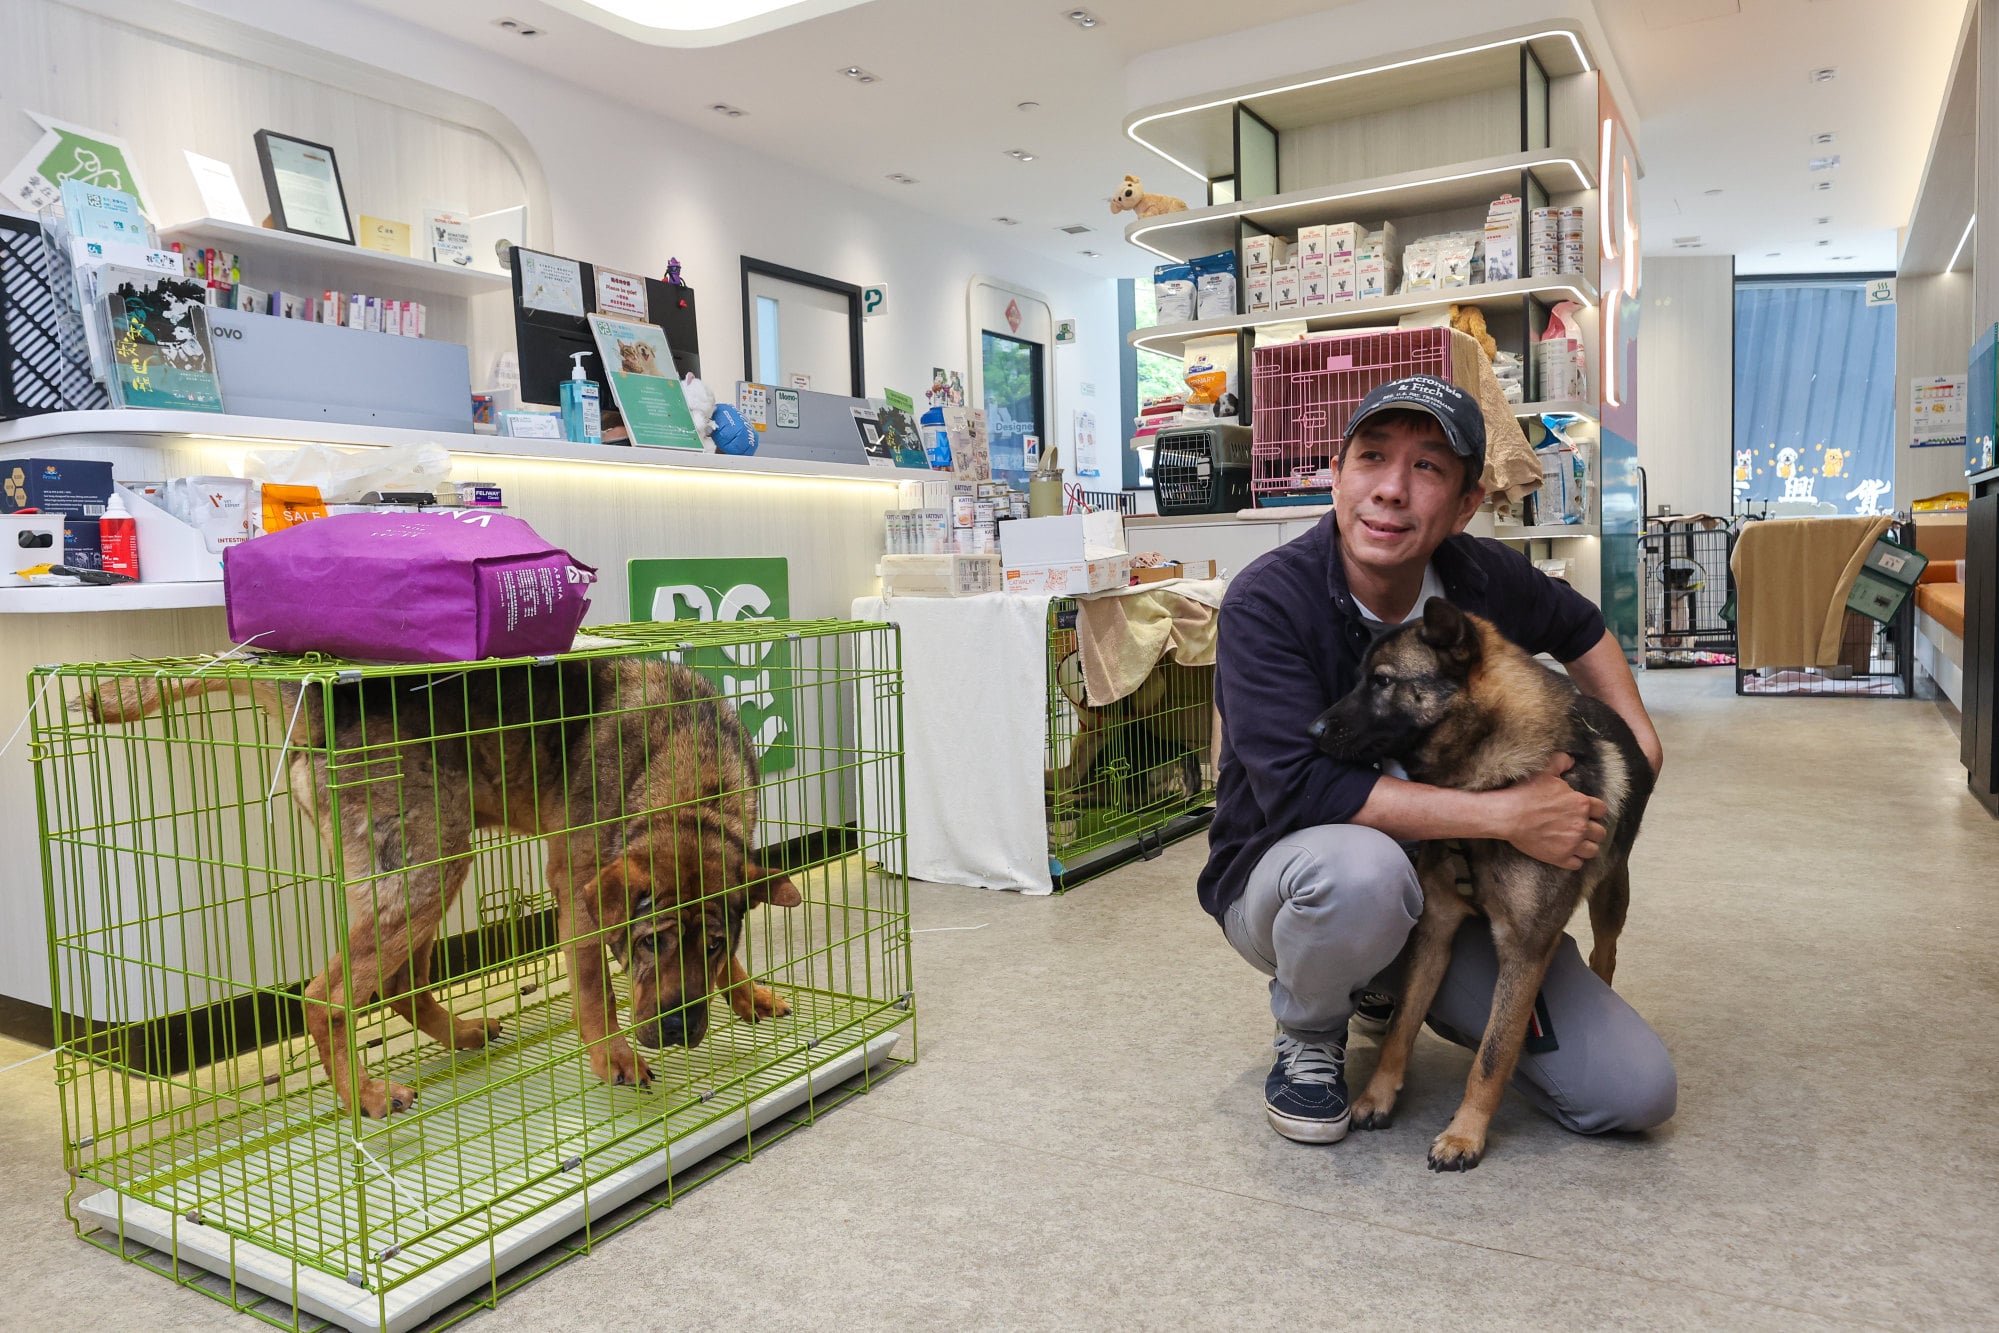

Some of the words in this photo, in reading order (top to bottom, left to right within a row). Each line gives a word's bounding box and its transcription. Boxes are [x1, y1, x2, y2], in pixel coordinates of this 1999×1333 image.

[1412, 383, 1444, 398] Fitch
[996, 422, 1034, 433] Designe
[283, 510, 320, 522] SALE
